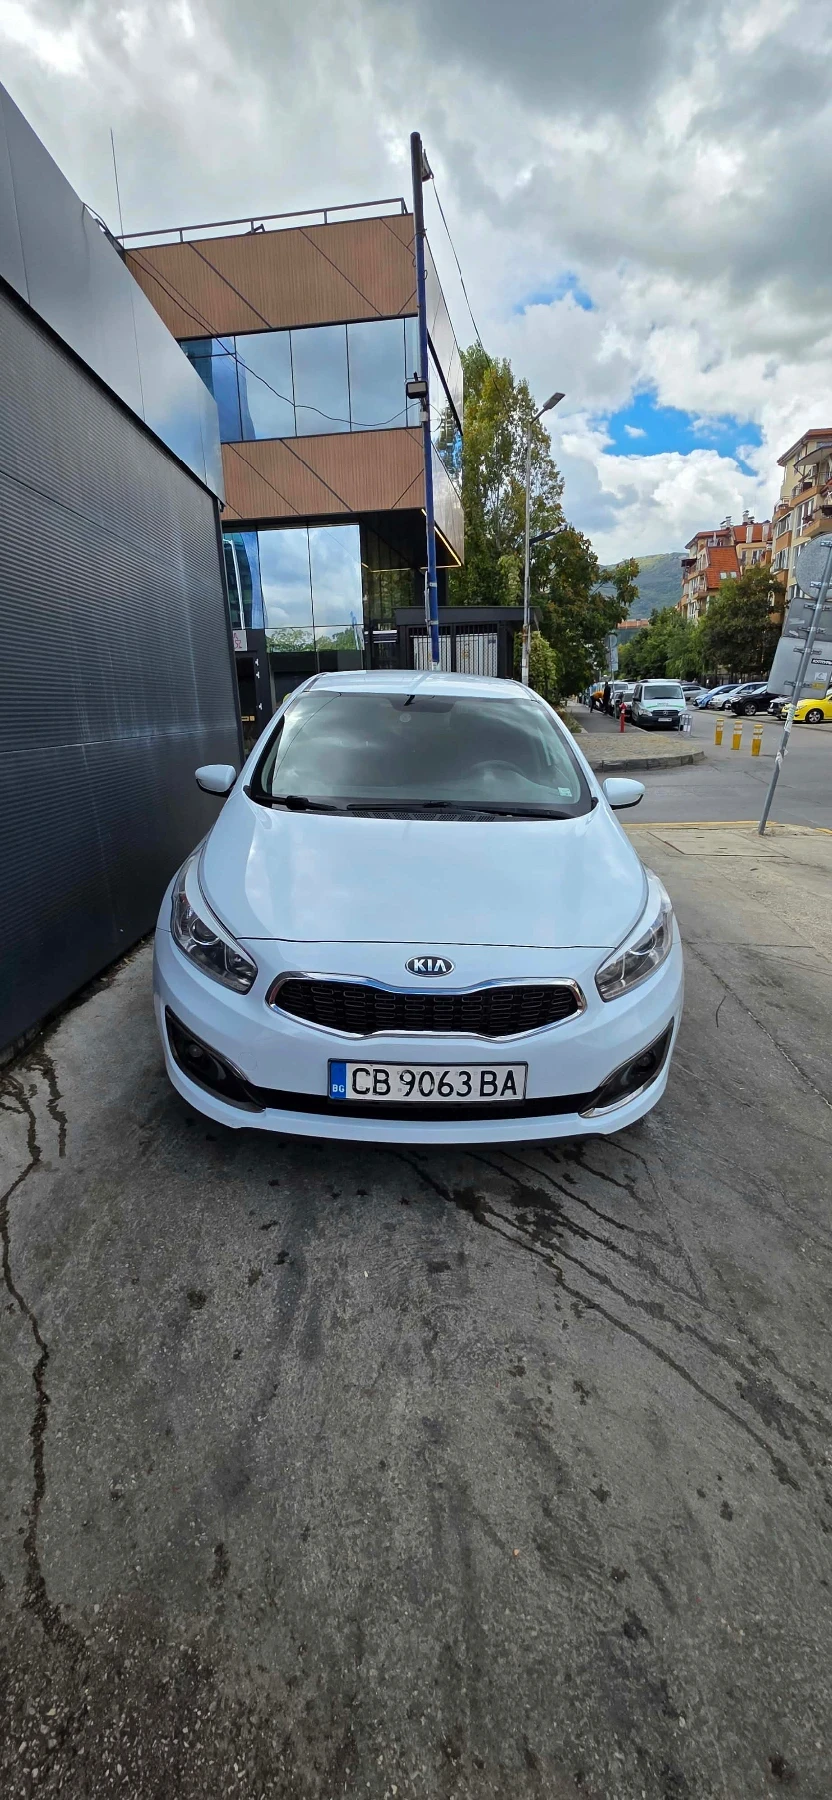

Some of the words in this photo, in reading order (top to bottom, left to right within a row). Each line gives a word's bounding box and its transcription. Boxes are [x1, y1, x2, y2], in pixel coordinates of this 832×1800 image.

[413, 958, 447, 972] KIA
[332, 1084, 345, 1093] BG
[351, 1067, 391, 1096] CB
[399, 1069, 473, 1098] 9063
[479, 1069, 518, 1097] BA
